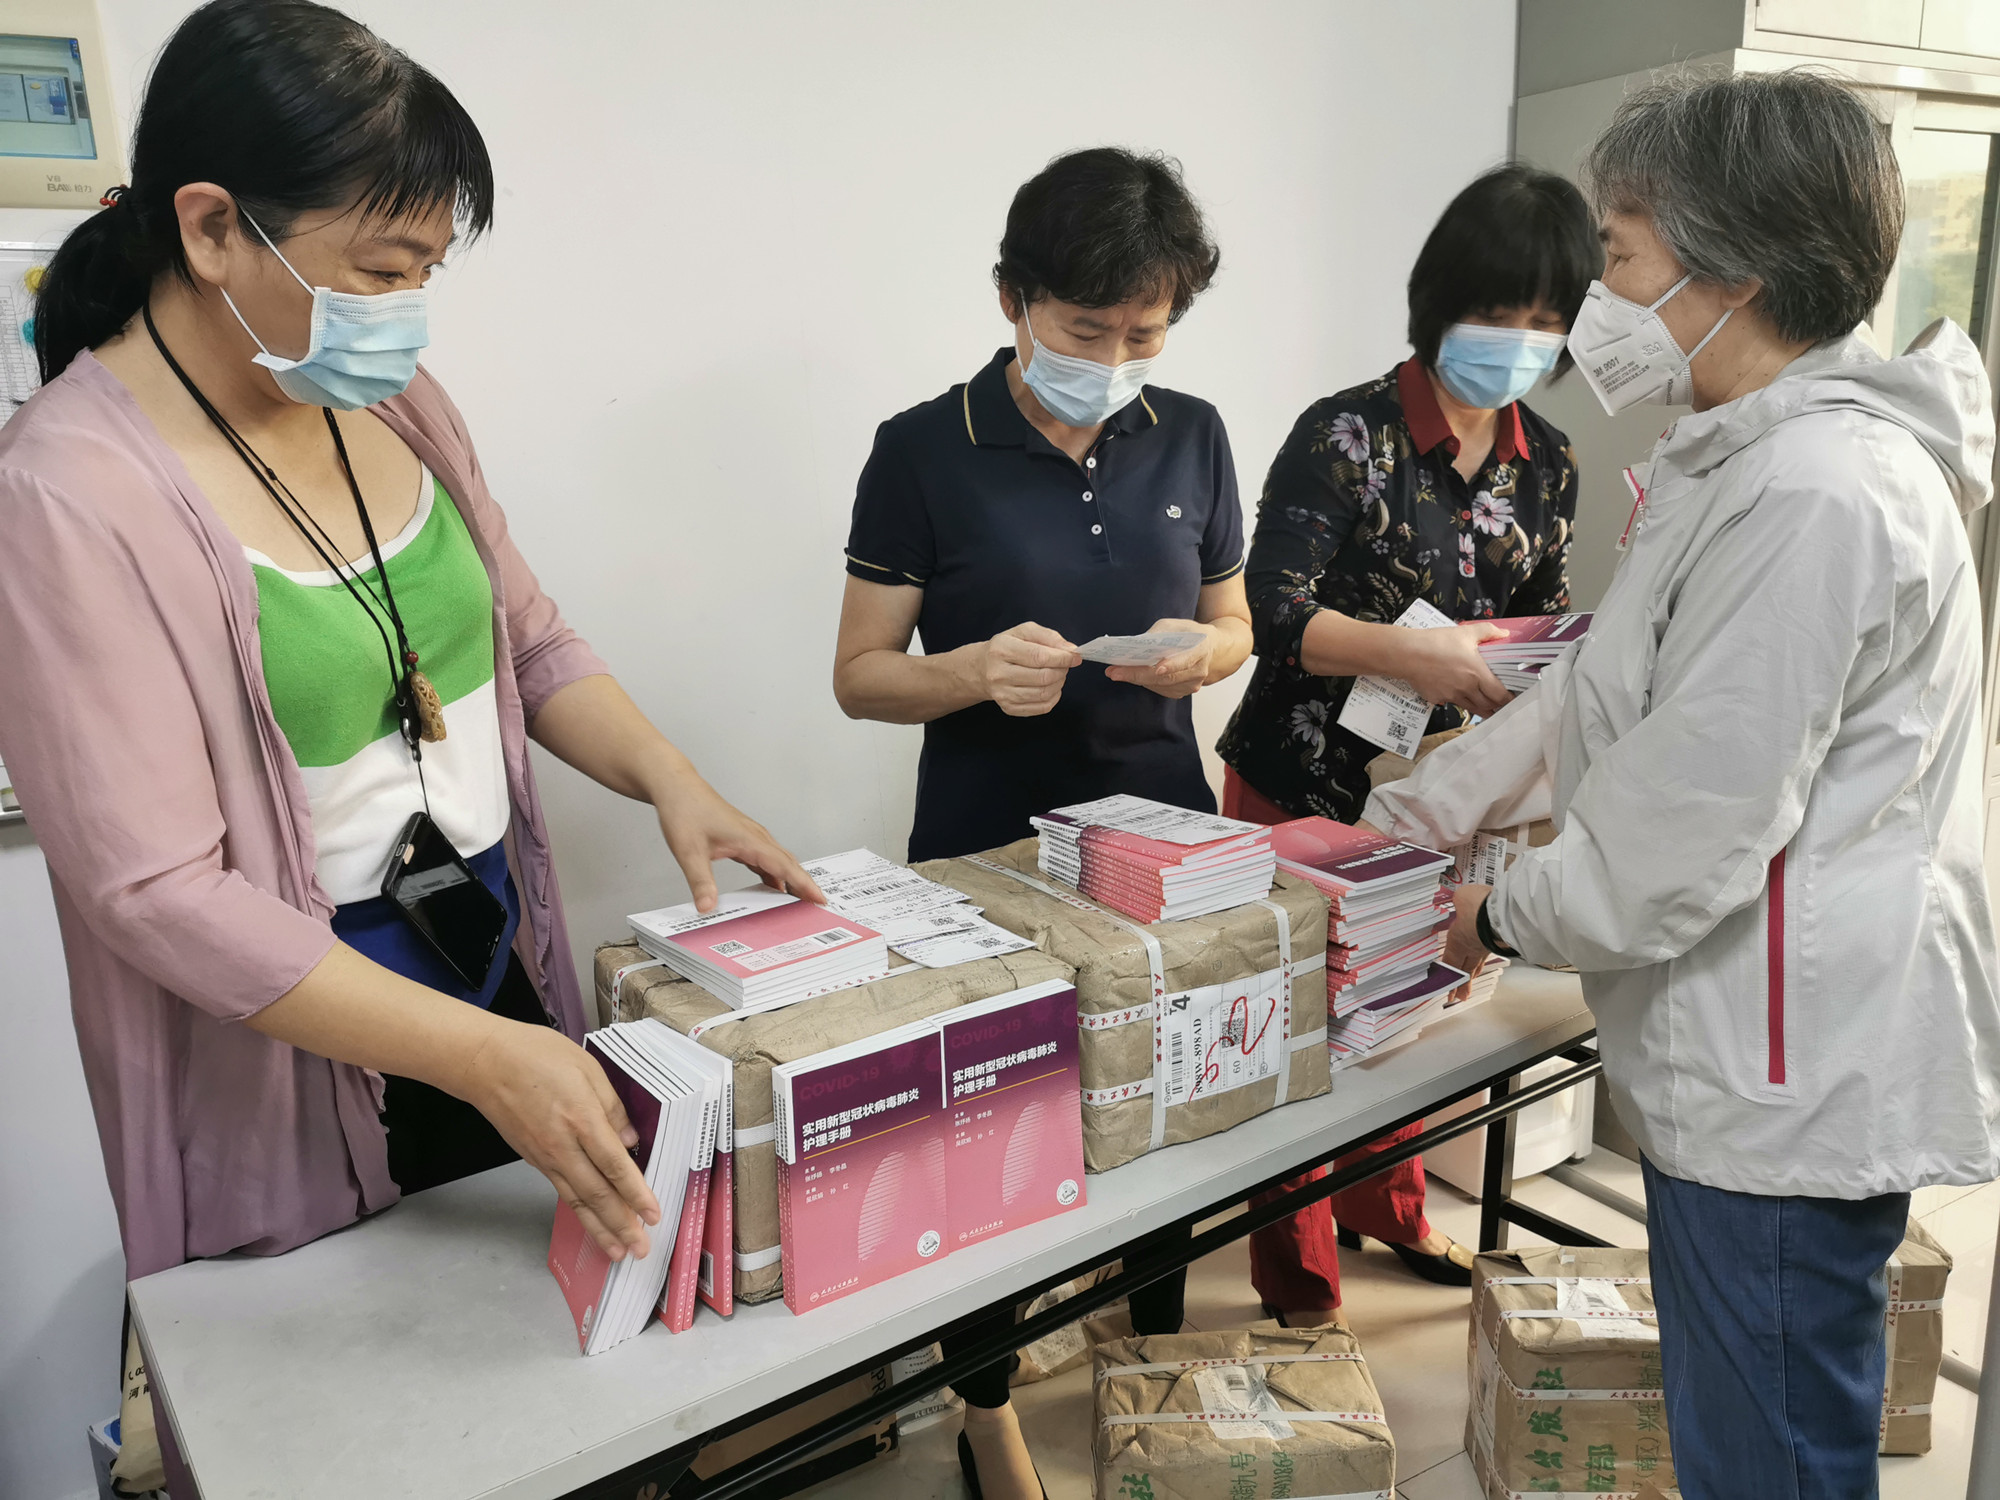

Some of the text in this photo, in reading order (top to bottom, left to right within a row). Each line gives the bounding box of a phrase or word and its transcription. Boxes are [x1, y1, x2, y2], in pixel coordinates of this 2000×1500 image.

[1603, 356, 1620, 371] 9001
[951, 1018, 1022, 1048] COVID-19
[952, 1041, 1058, 1083] 实用新型冠状病毒肺炎
[800, 1066, 880, 1100] COVID-19
[953, 1074, 997, 1098] 护理手册
[802, 1088, 920, 1138] 实用新型冠状病毒肺炎
[802, 1125, 852, 1152] 护理手册
